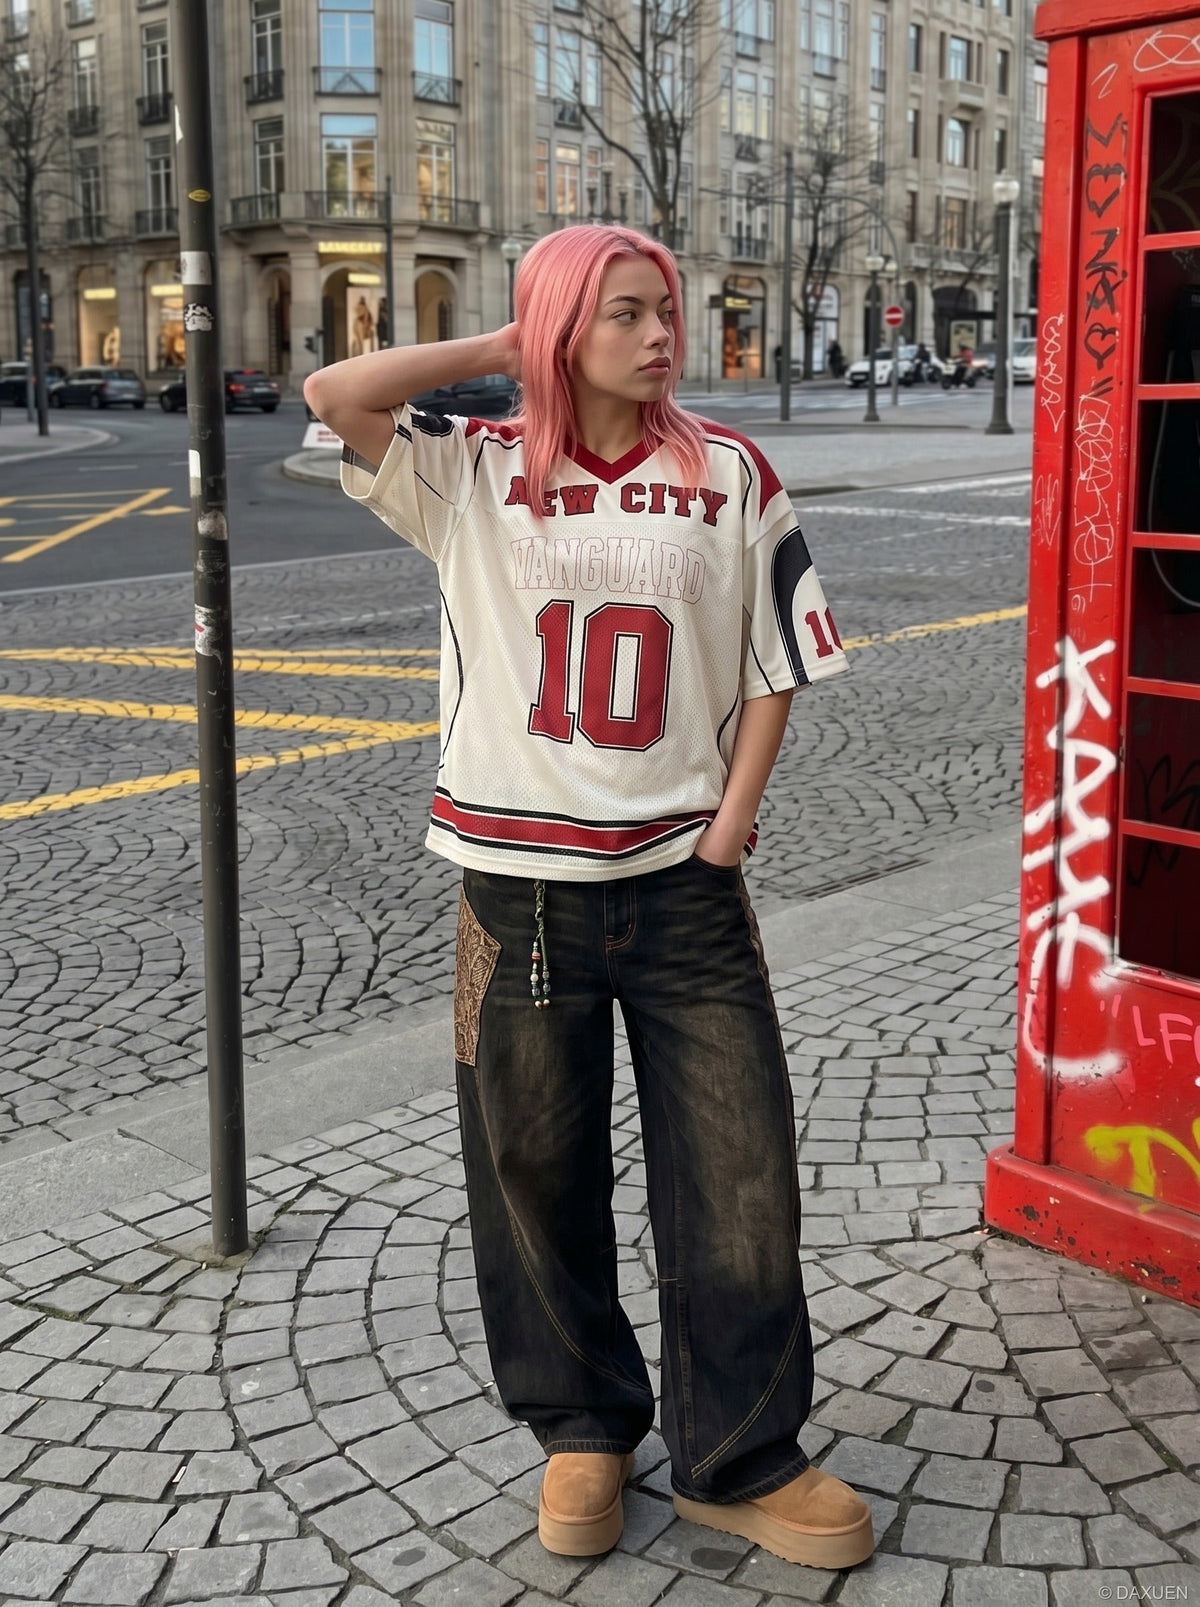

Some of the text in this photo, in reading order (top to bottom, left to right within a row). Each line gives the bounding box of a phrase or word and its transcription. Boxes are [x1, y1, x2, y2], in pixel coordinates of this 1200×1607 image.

[620, 483, 728, 527] CITY
[510, 536, 706, 605] VANGUARD
[804, 606, 843, 659] 1
[528, 599, 673, 751] 10
